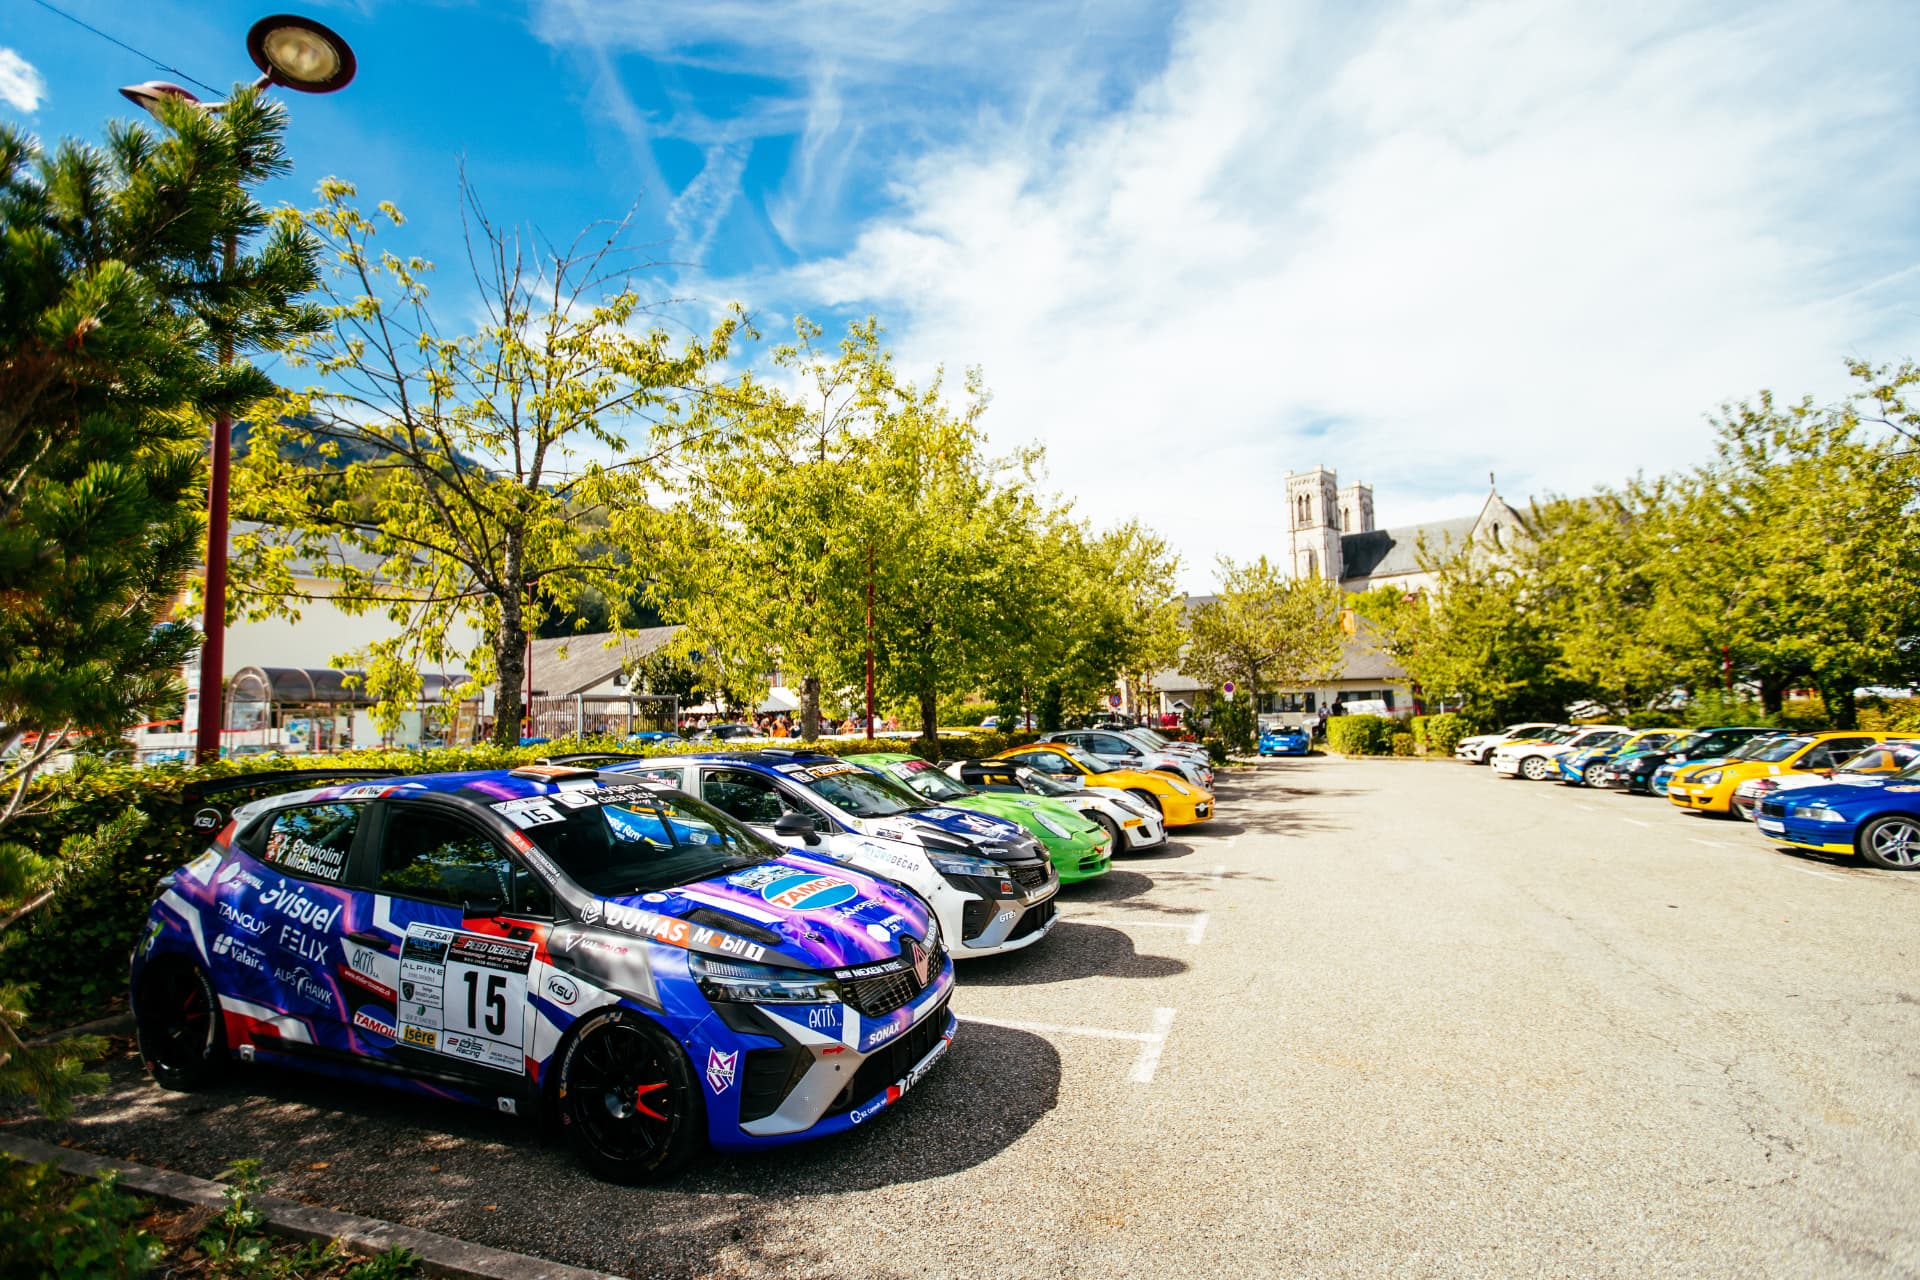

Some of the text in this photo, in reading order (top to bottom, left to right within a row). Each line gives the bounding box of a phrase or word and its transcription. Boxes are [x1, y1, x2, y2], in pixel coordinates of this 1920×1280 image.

[193, 815, 217, 829] KSU
[521, 809, 554, 824] 15
[285, 851, 342, 881] Micheloud
[772, 877, 847, 907] TAMOIL
[219, 901, 271, 935] TANGUY
[606, 909, 688, 942] DUMAS
[279, 924, 329, 966] FELIX
[424, 930, 447, 940] FFSA
[693, 927, 748, 954] Mobil
[232, 946, 260, 968] Valair
[402, 962, 445, 976] ALPINE
[853, 963, 883, 977] NEXEN
[274, 967, 297, 986] ALPS
[305, 981, 333, 1004] HAWK
[548, 980, 574, 1002] KSU
[464, 970, 507, 1036] 15
[355, 1012, 397, 1039] TAMOIL
[404, 1024, 435, 1045] isère
[869, 1022, 901, 1046] SONAX
[456, 1047, 481, 1058] Racing
[707, 1067, 734, 1076] DESIGN
